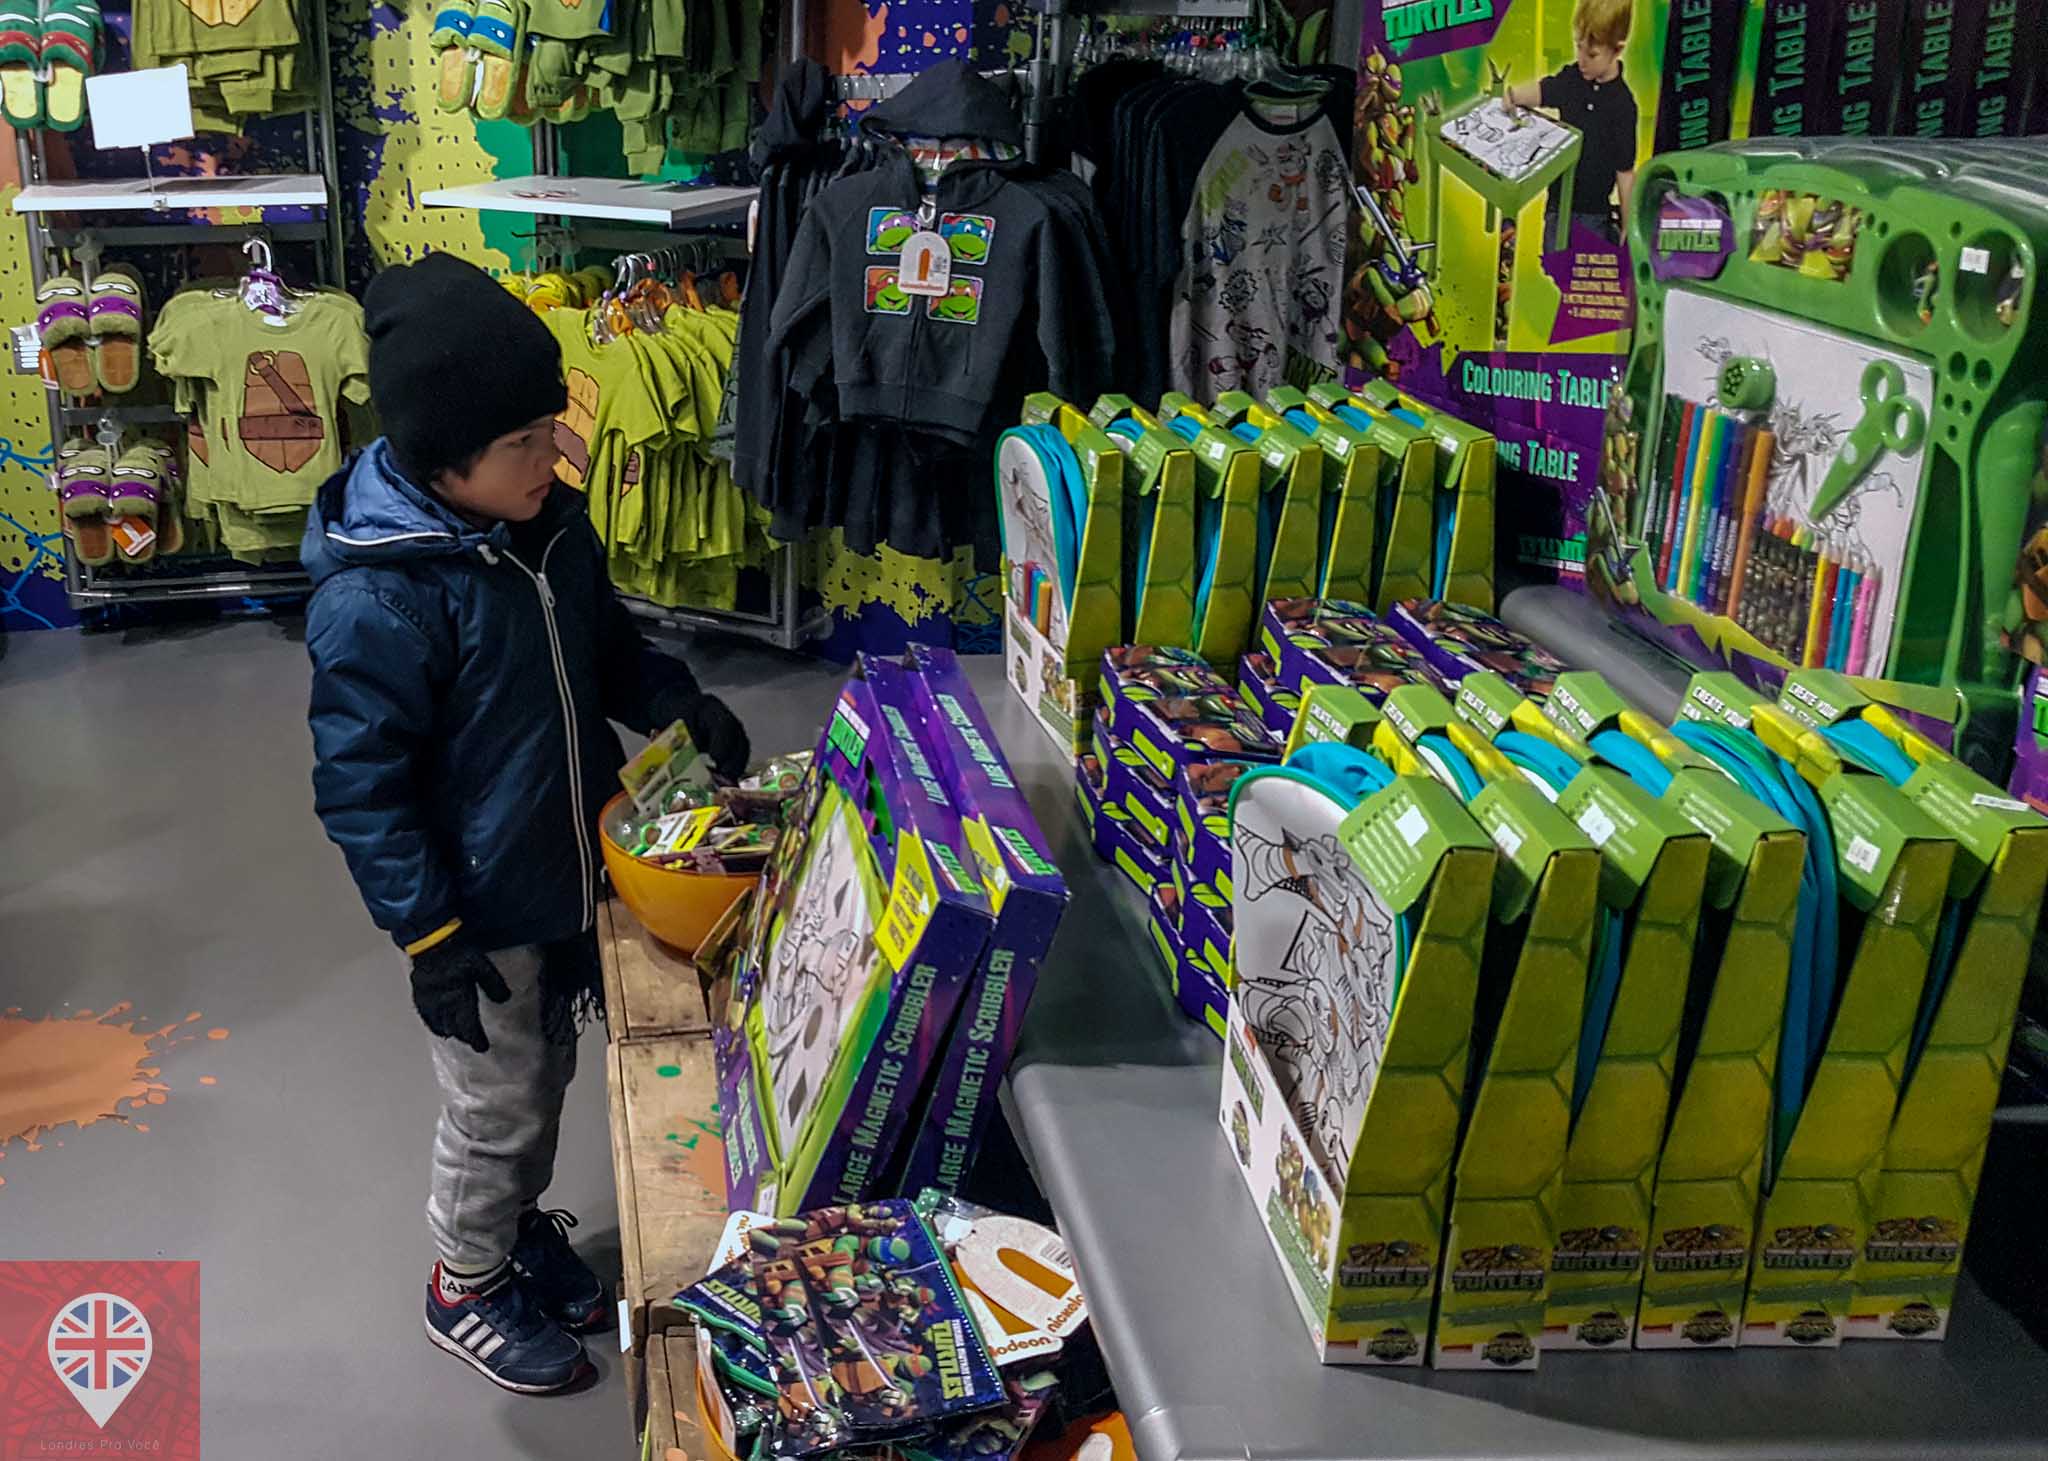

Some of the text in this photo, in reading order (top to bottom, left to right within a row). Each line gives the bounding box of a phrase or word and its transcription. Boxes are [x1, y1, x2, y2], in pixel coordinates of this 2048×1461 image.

[1674, 0, 1712, 93] TABLE
[1768, 3, 1807, 97] TABLE
[1838, 1, 1877, 95] TABLE
[1914, 0, 1952, 93] TABLE
[1976, 0, 2017, 89] TABLE
[1462, 358, 1552, 402] COLOURING
[1527, 440, 1579, 482] TABLE
[1462, 688, 1488, 715] CREATE
[1554, 686, 1580, 713] CREATE
[1692, 686, 1725, 714] CREATE
[1787, 682, 1819, 708] CREATE
[885, 963, 939, 1056] SCRIBBLER
[944, 1047, 991, 1138] MAGNETIC
[969, 948, 1016, 1043] SCRIBBLER
[851, 1058, 905, 1149] MAGNETIC
[831, 1150, 873, 1205] LARGE
[1454, 1273, 1543, 1291] TURTLES
[929, 1319, 965, 1400] TURTLES
